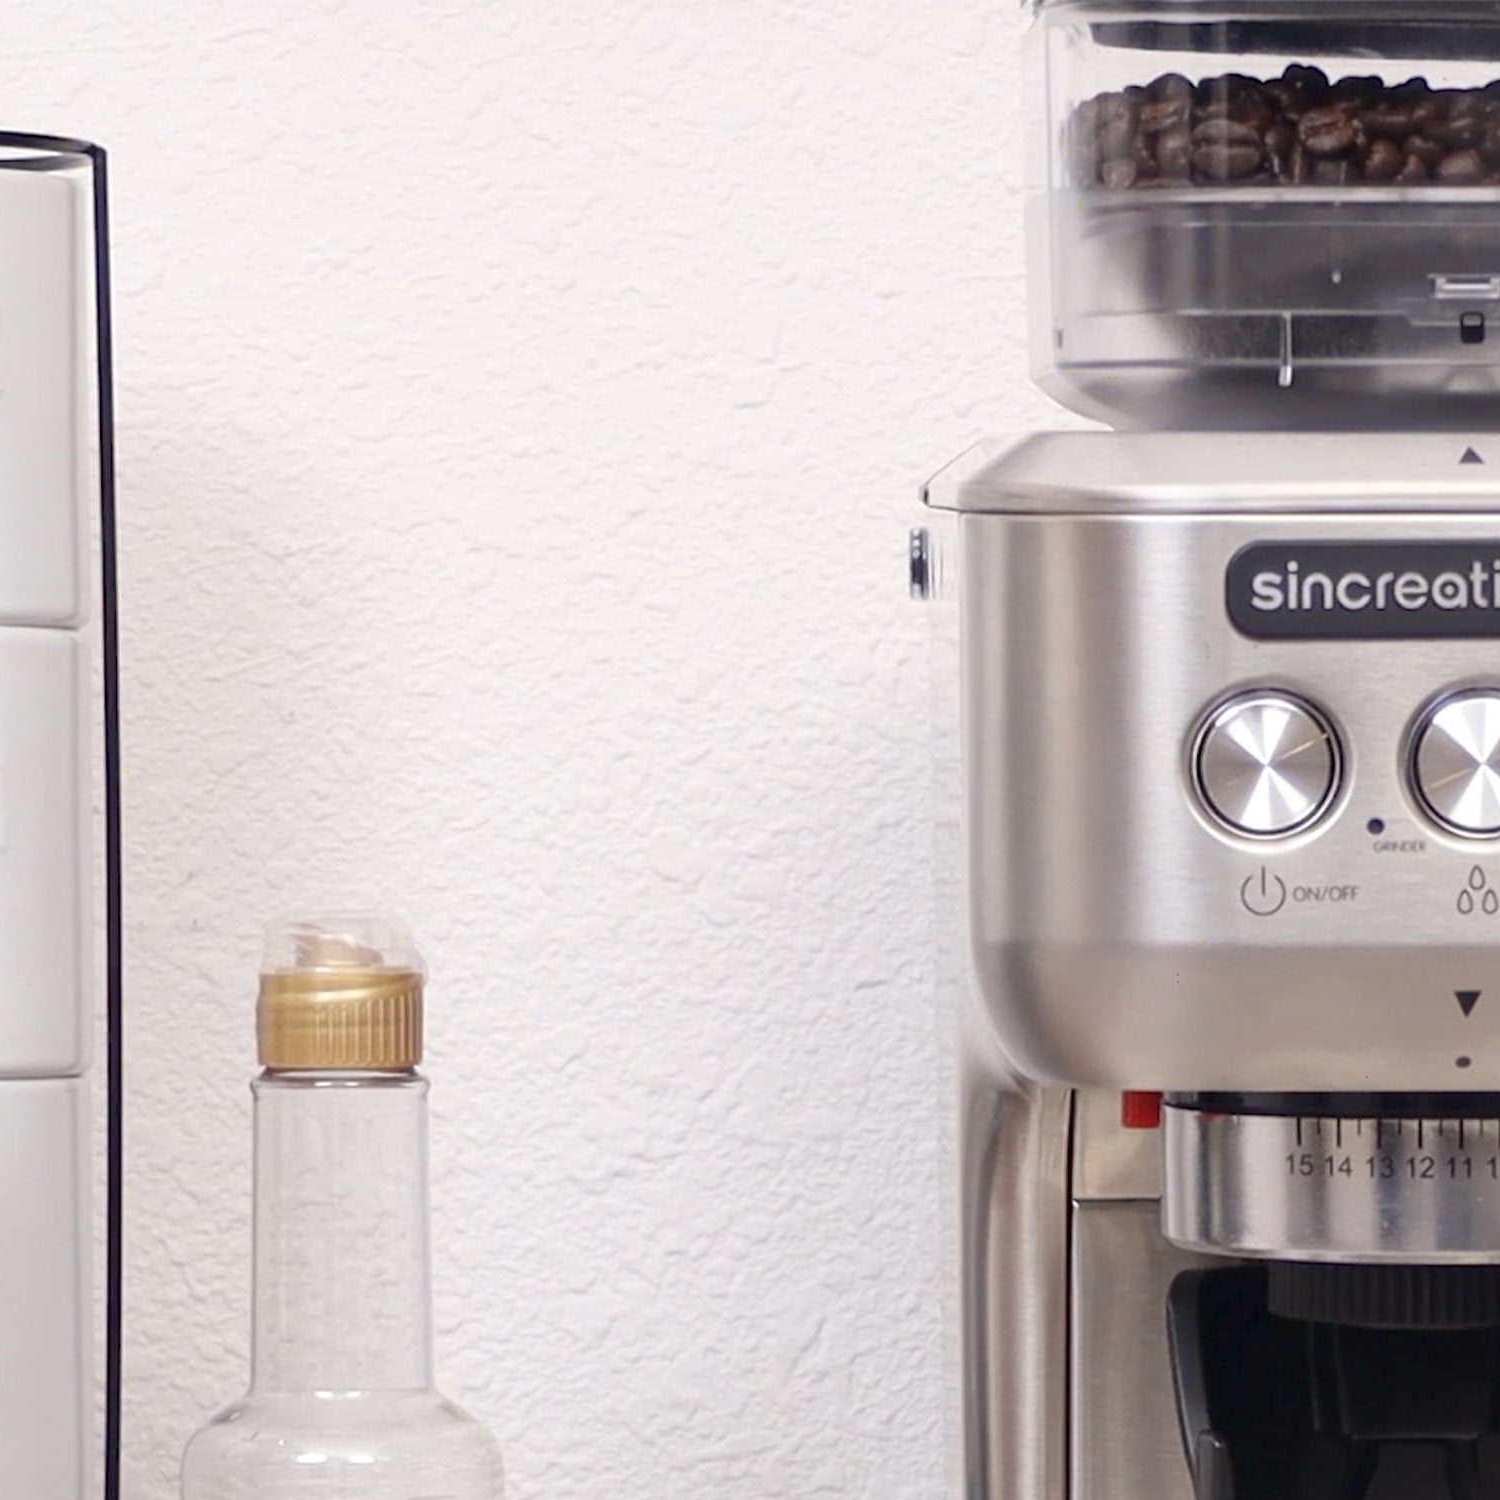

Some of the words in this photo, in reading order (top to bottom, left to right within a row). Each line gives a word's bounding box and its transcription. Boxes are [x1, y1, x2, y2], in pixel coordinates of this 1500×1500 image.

[1292, 885, 1361, 902] ON/OFF
[1285, 1154, 1314, 1176] 15
[1325, 1155, 1353, 1177] 14
[1366, 1156, 1395, 1178] 13
[1407, 1156, 1435, 1178] 12
[1447, 1157, 1472, 1178] 11
